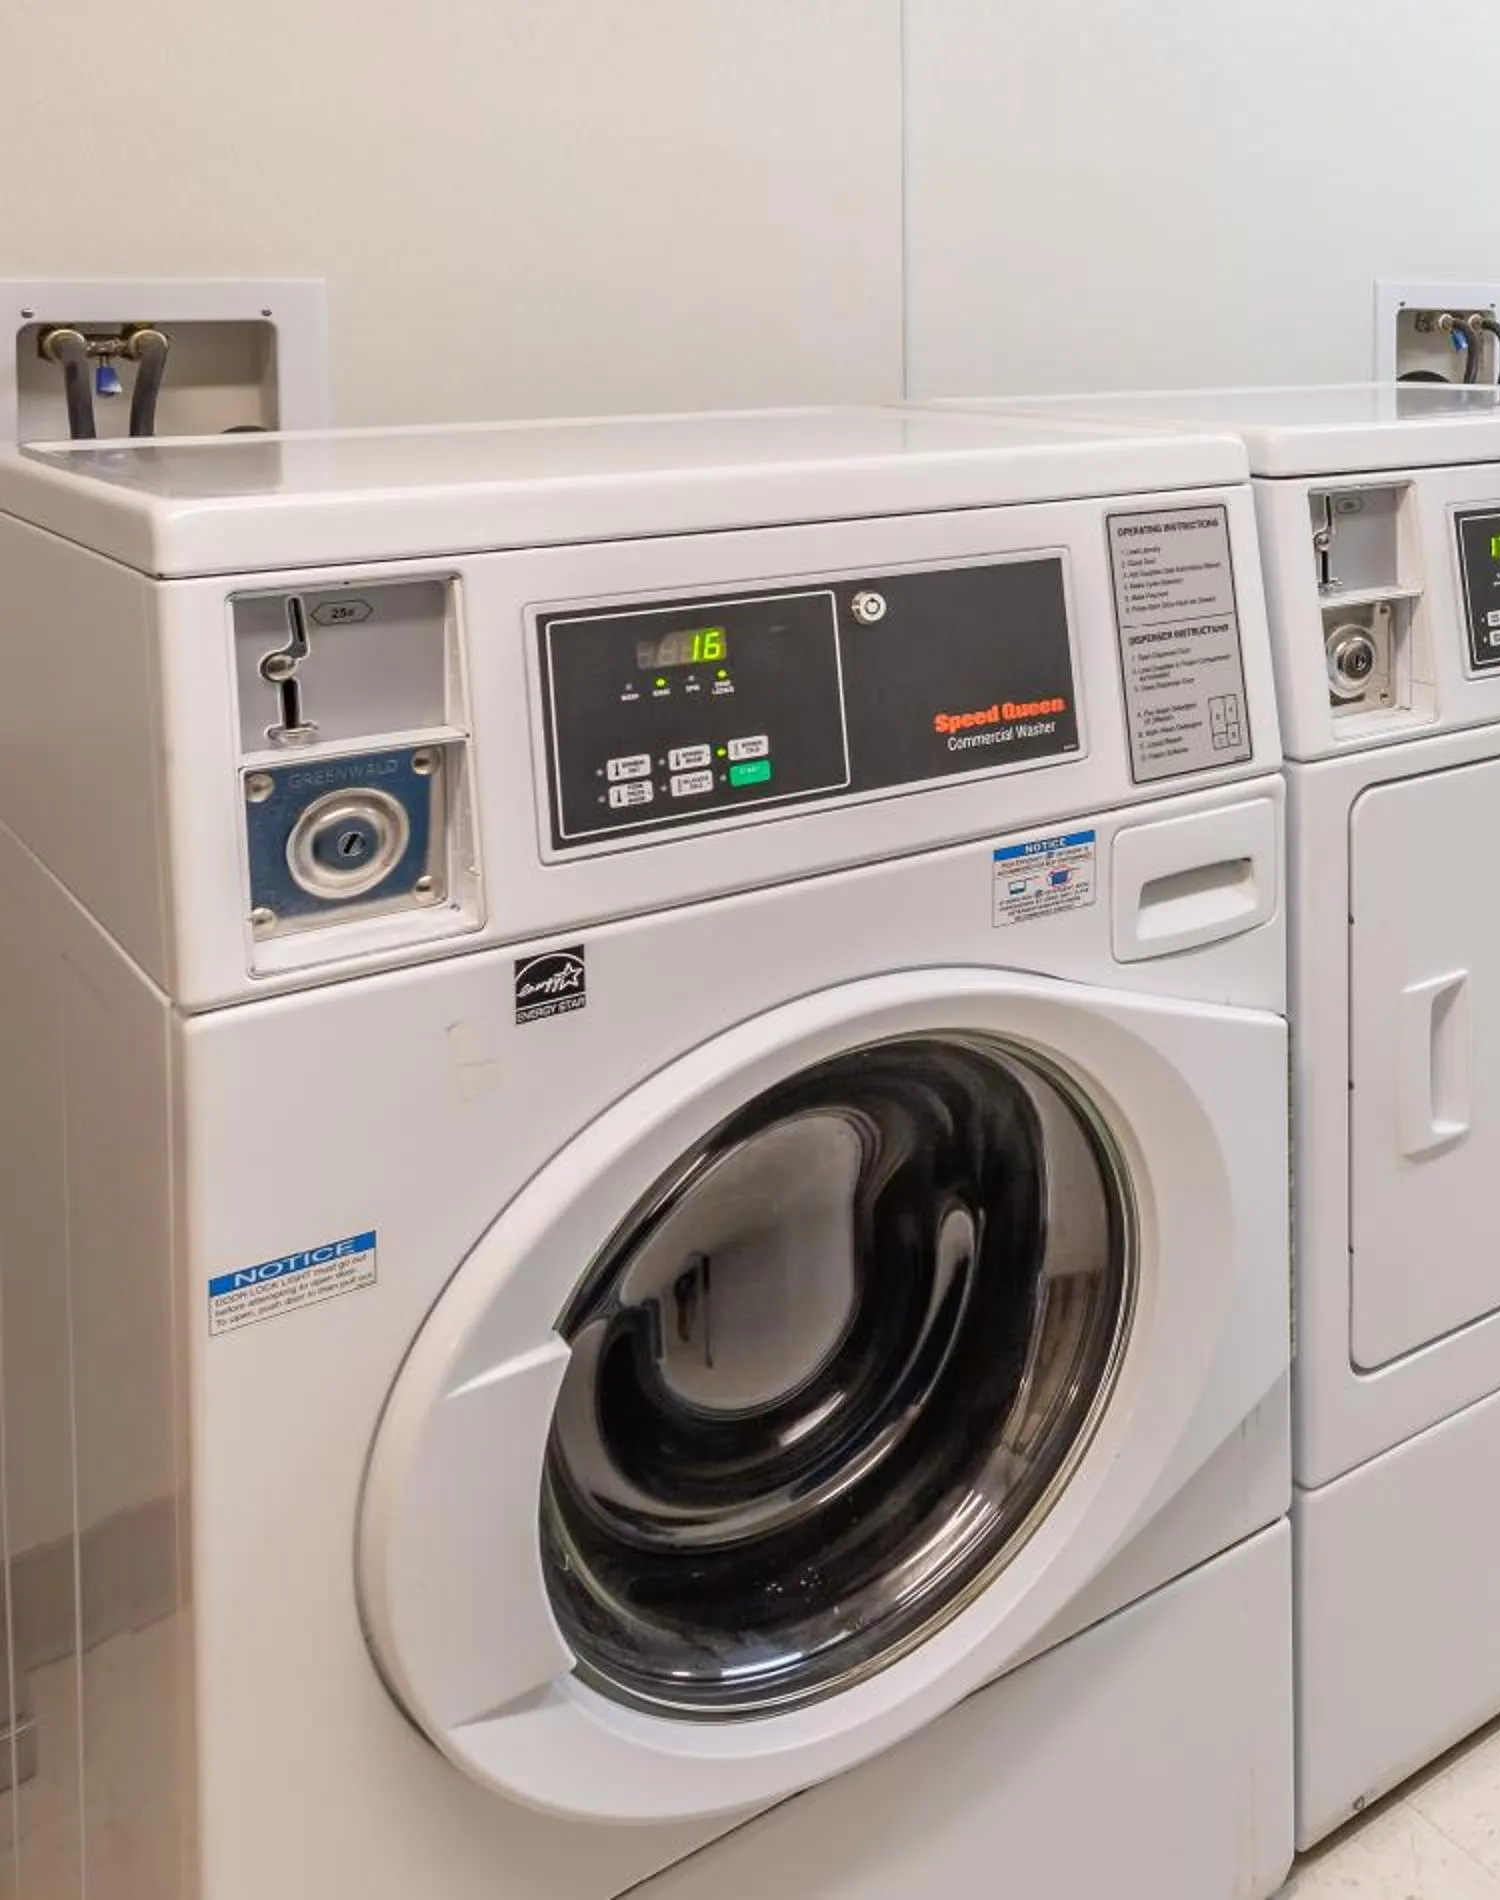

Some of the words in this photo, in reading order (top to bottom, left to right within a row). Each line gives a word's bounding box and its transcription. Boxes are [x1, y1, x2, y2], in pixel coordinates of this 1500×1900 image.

[691, 630, 721, 663] 16
[934, 703, 1000, 734] Speed
[1001, 697, 1067, 721] Queen
[947, 725, 1014, 751] Commercial
[1015, 720, 1056, 739] Washer
[287, 759, 400, 790] GREENWALD
[1025, 839, 1067, 853] NOTICE
[234, 1241, 355, 1288] NOTICE
